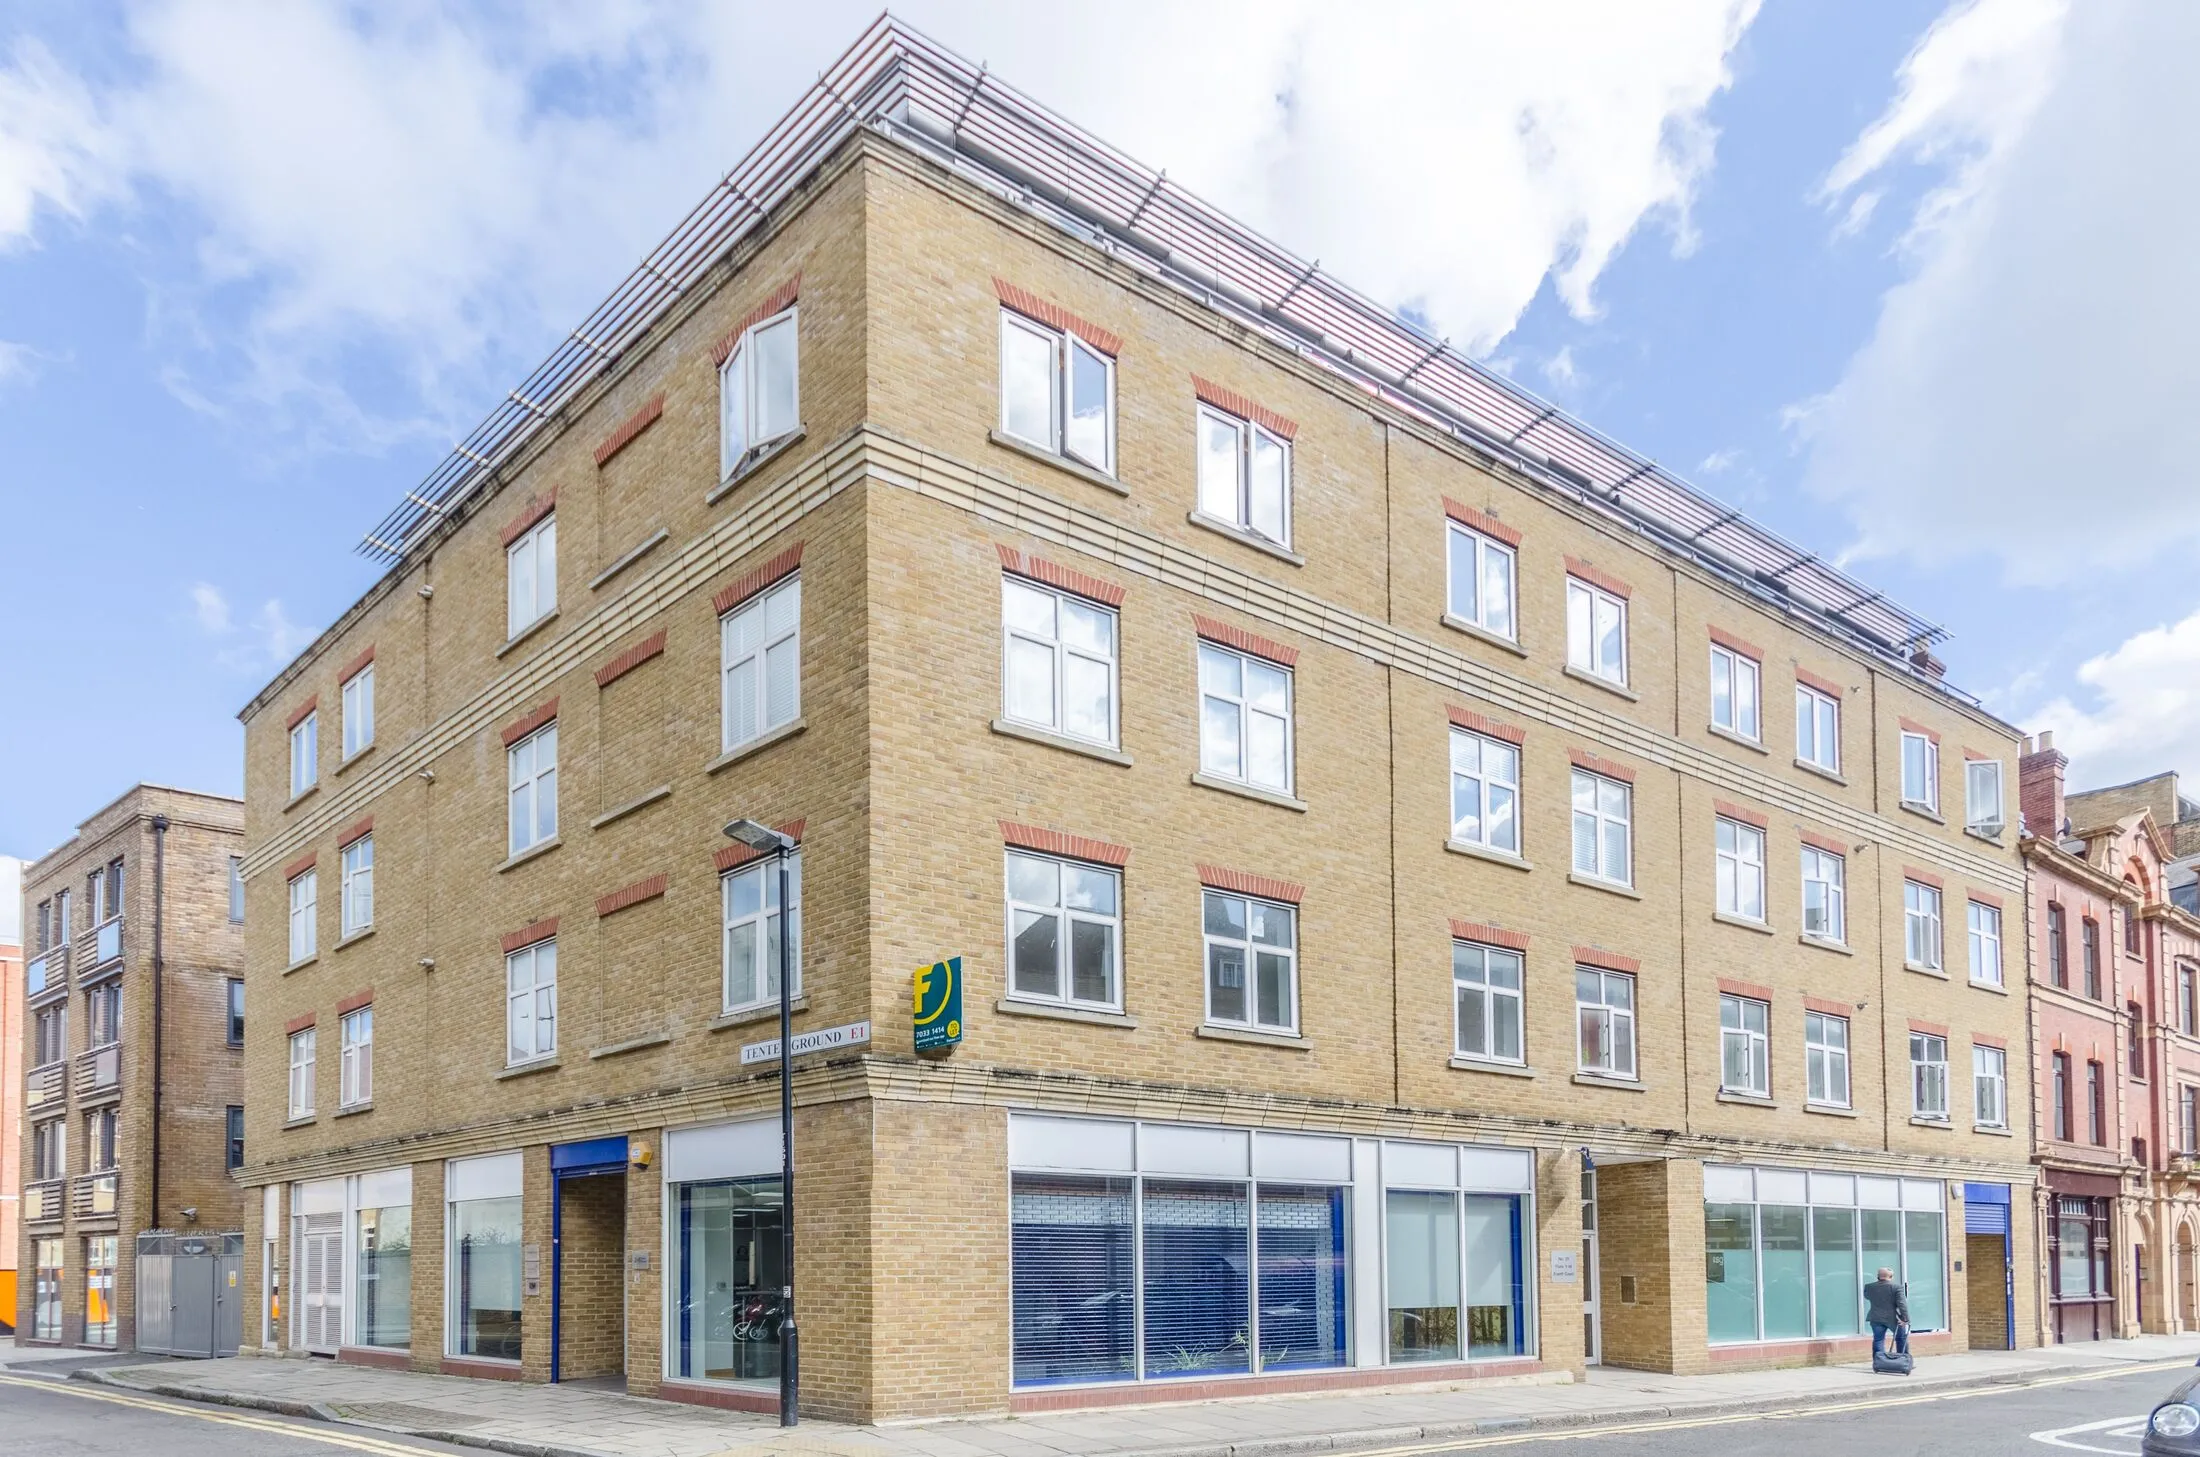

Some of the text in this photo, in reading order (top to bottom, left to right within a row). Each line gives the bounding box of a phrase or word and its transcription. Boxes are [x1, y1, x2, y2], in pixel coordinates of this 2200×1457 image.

[745, 1026, 864, 1060] TENTE GROUND E1
[916, 1026, 945, 1038] 7033 1414
